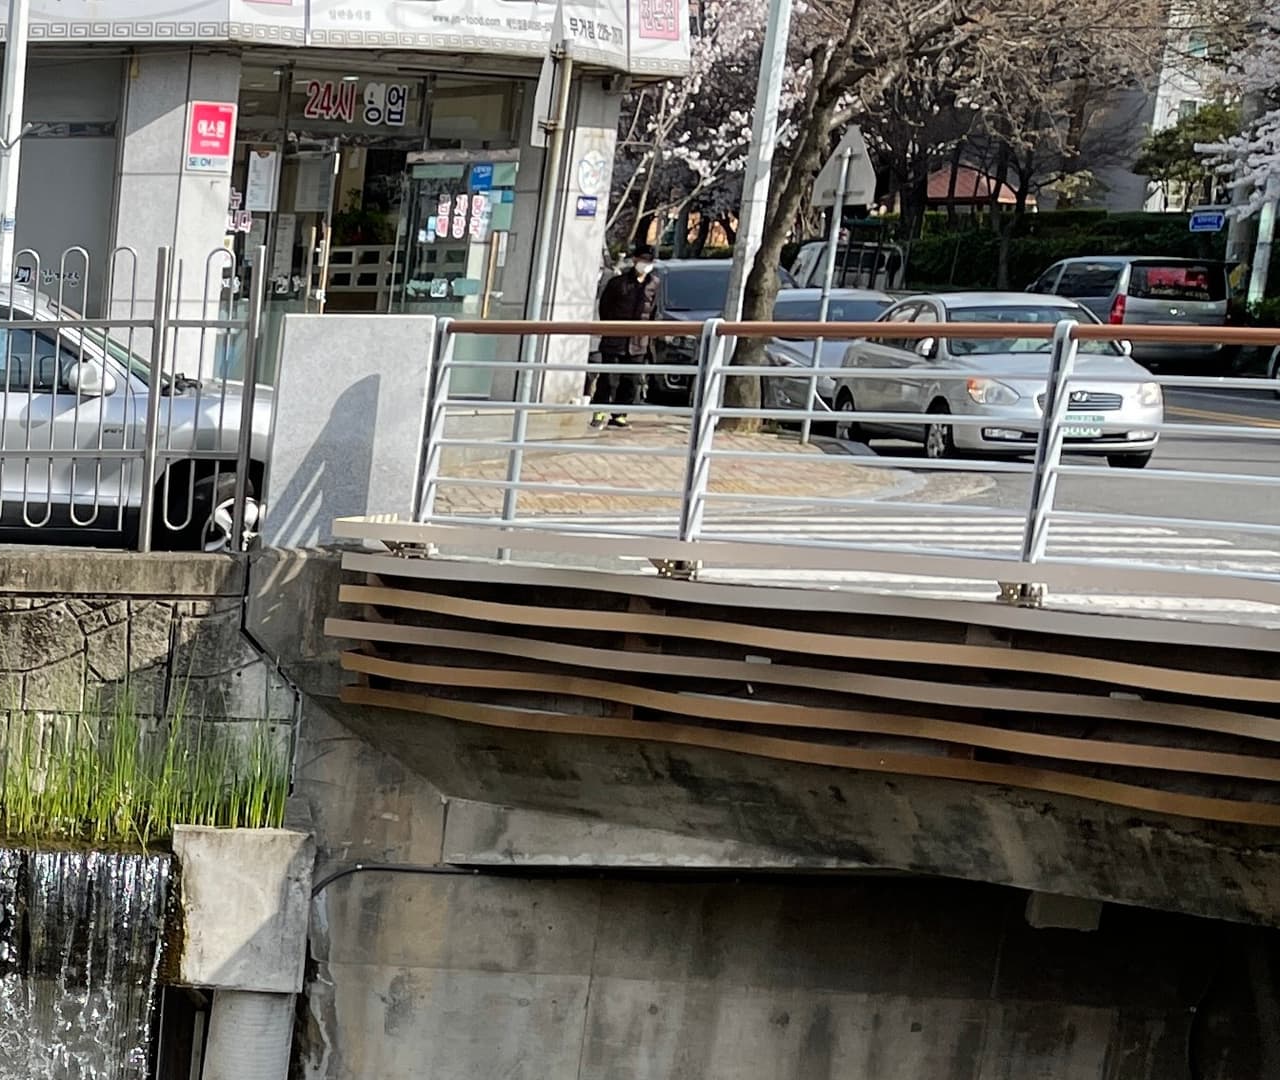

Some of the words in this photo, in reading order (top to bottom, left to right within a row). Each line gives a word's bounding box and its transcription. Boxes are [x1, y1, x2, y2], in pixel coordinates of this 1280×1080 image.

[569, 17, 596, 40] 무거점
[304, 79, 358, 123] 24시
[362, 82, 408, 126] 영업
